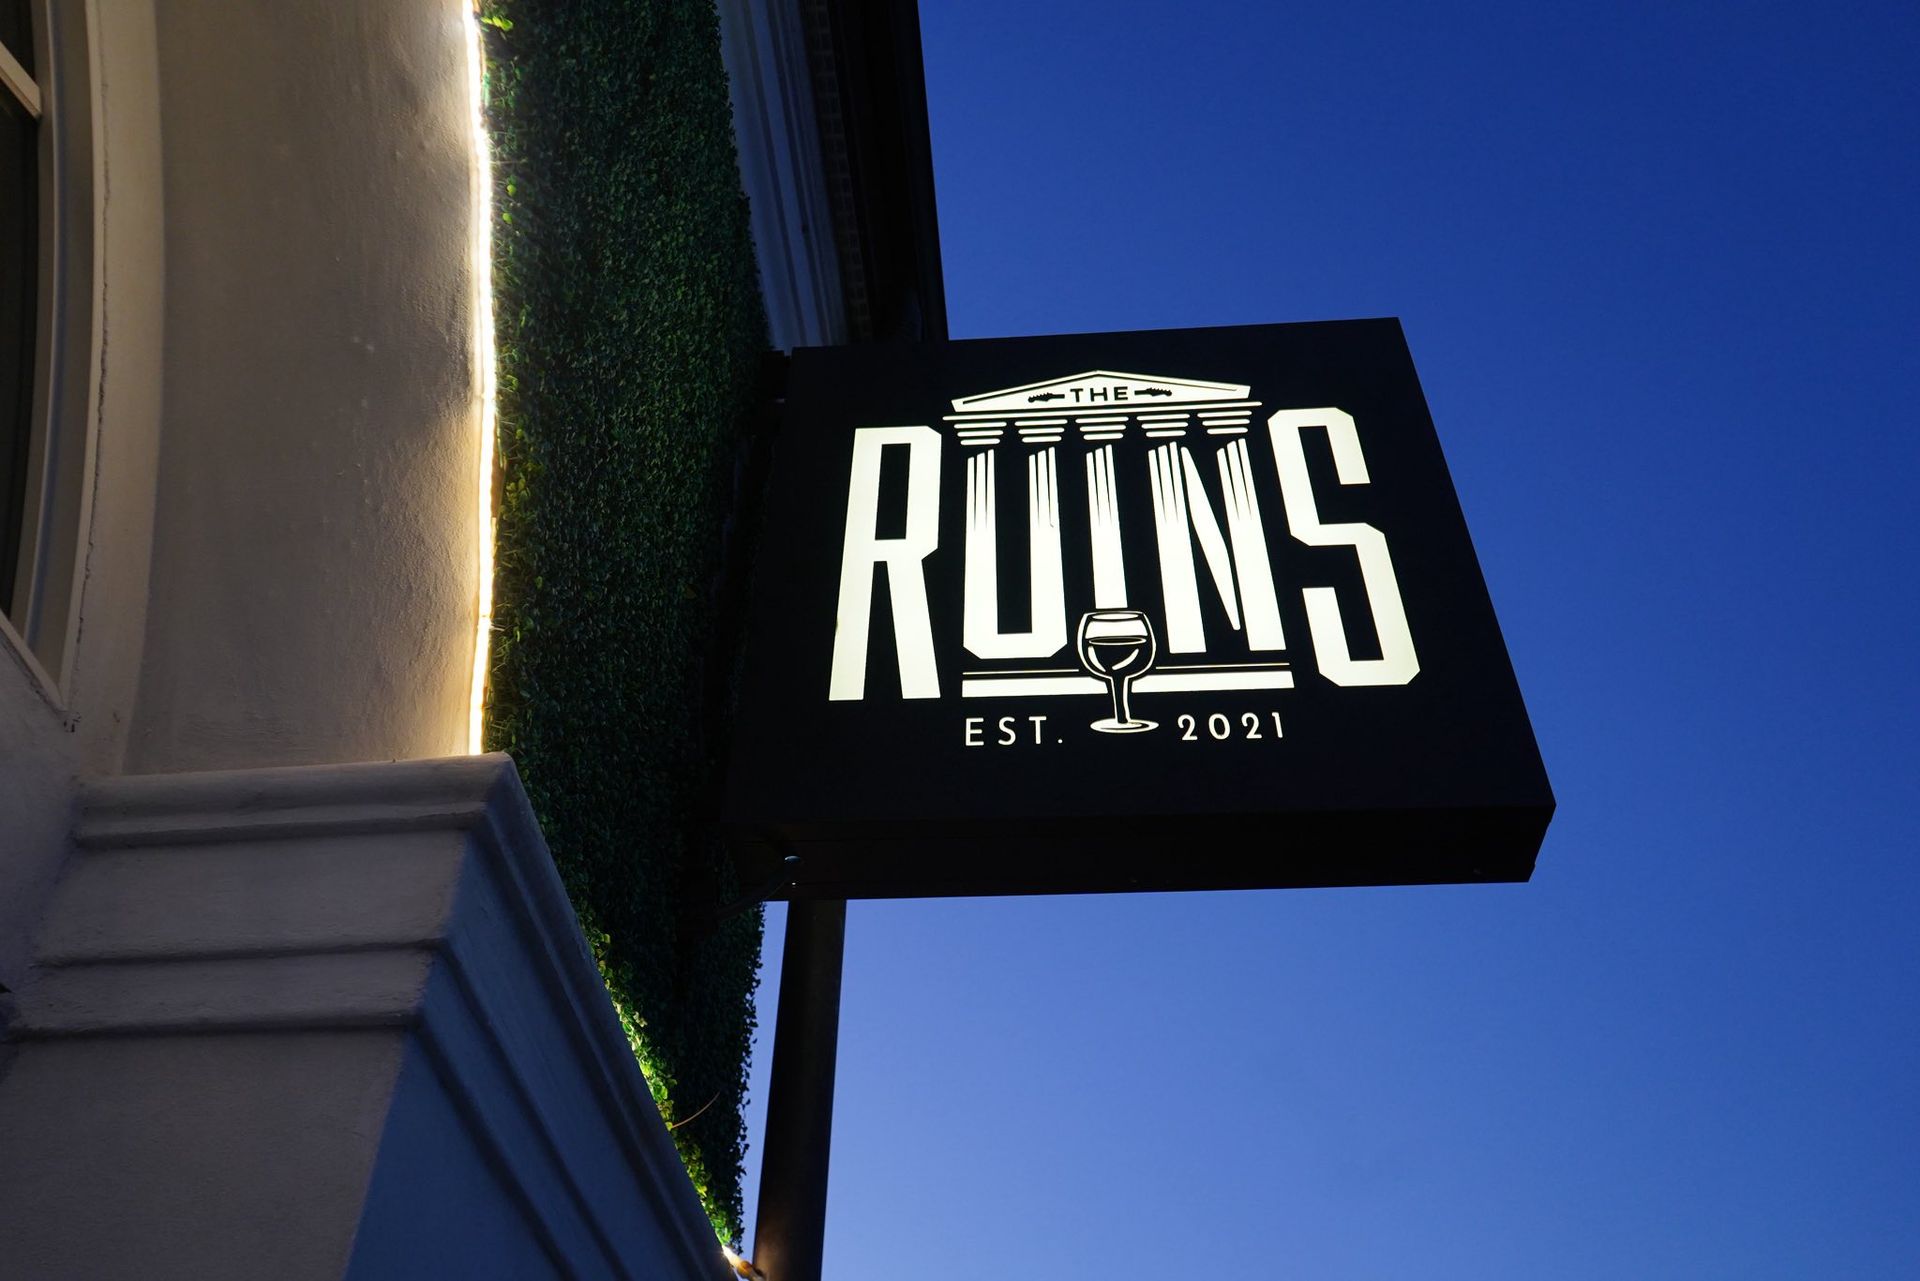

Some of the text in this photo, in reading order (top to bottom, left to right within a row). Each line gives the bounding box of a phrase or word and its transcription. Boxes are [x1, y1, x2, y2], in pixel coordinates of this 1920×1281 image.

[1069, 386, 1129, 403] THE
[828, 407, 1421, 701] RUINS
[965, 711, 1283, 746] EST. 2021
